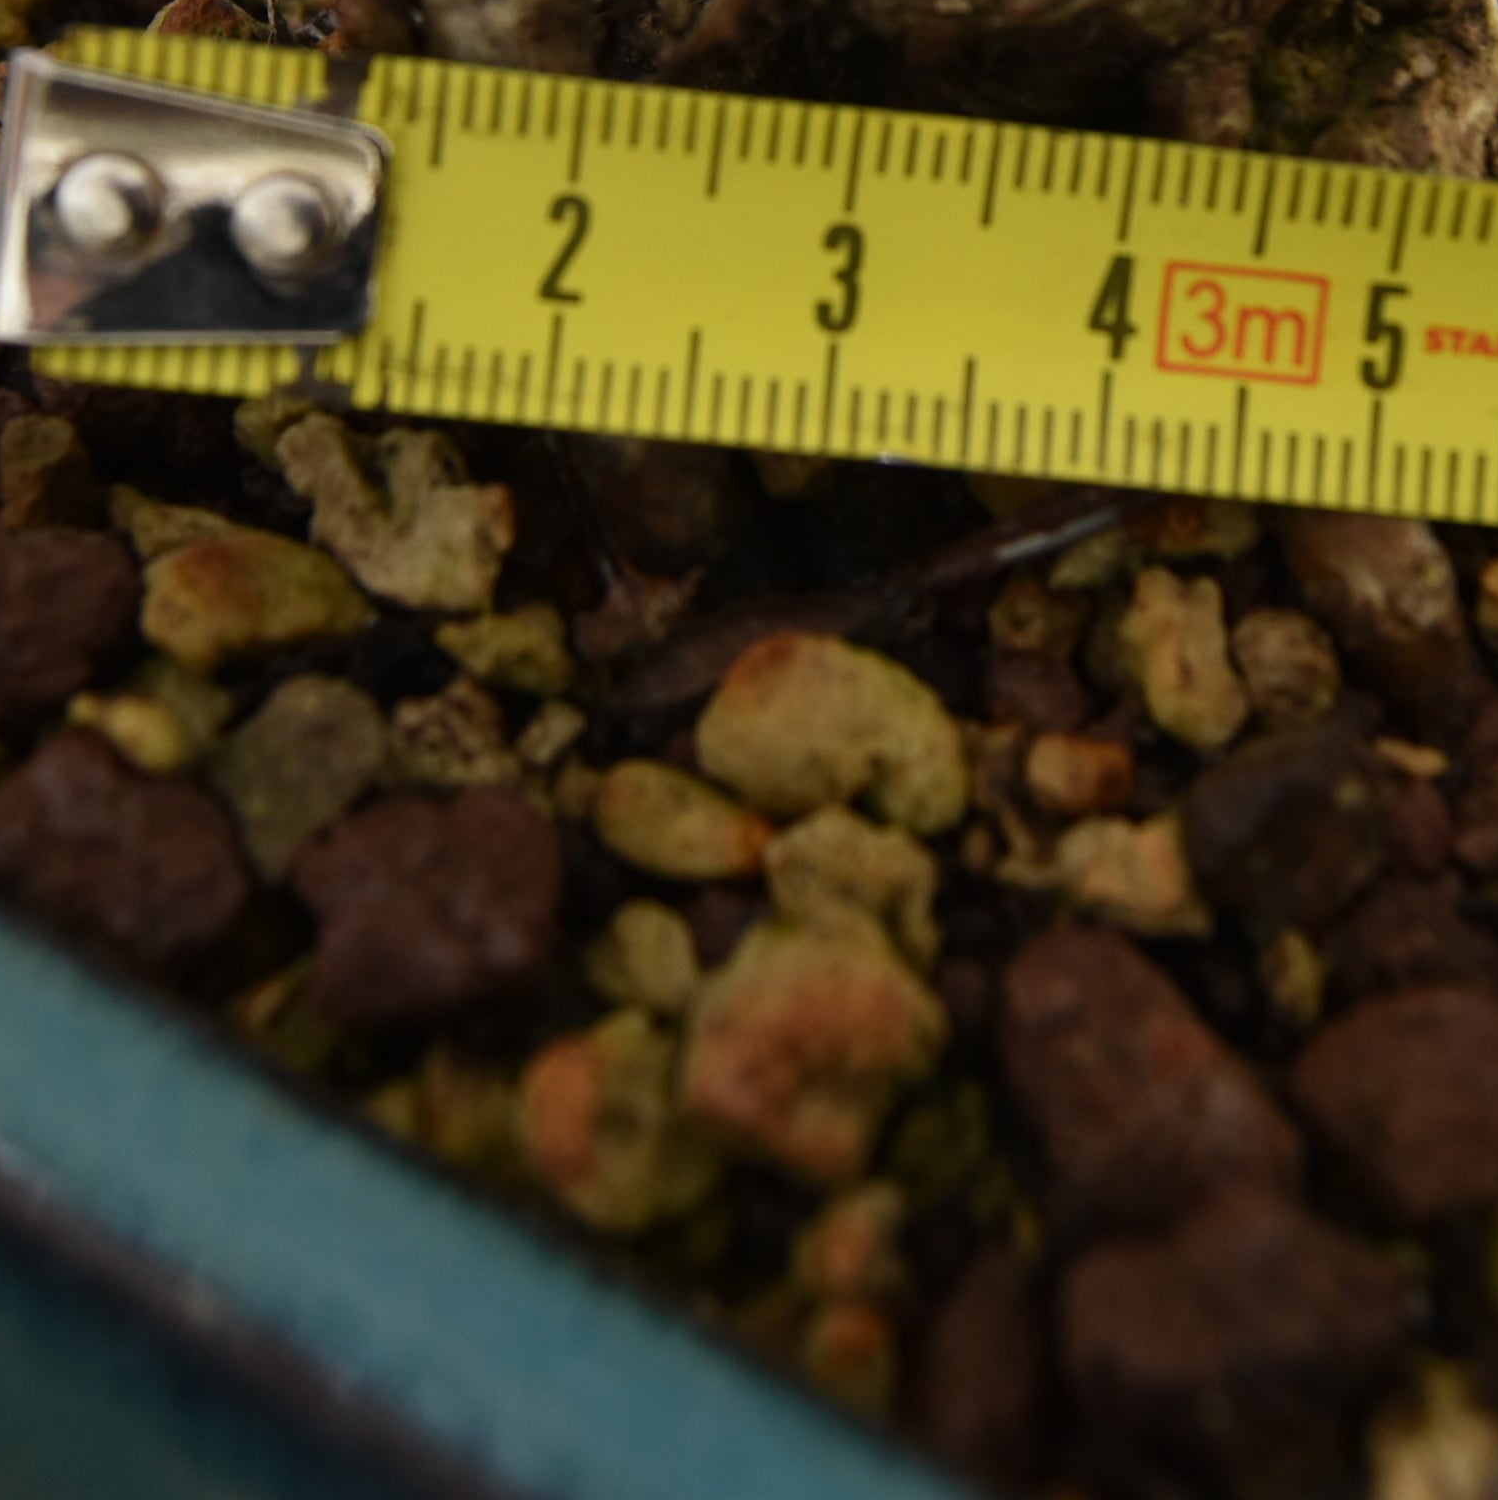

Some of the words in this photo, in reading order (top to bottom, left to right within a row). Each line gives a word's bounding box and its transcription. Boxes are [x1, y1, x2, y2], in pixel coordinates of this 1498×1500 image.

[538, 195, 592, 306] 2
[816, 224, 865, 333] 3
[1088, 254, 1137, 362] 4
[1180, 280, 1309, 367] 3m
[1360, 284, 1410, 392] 5
